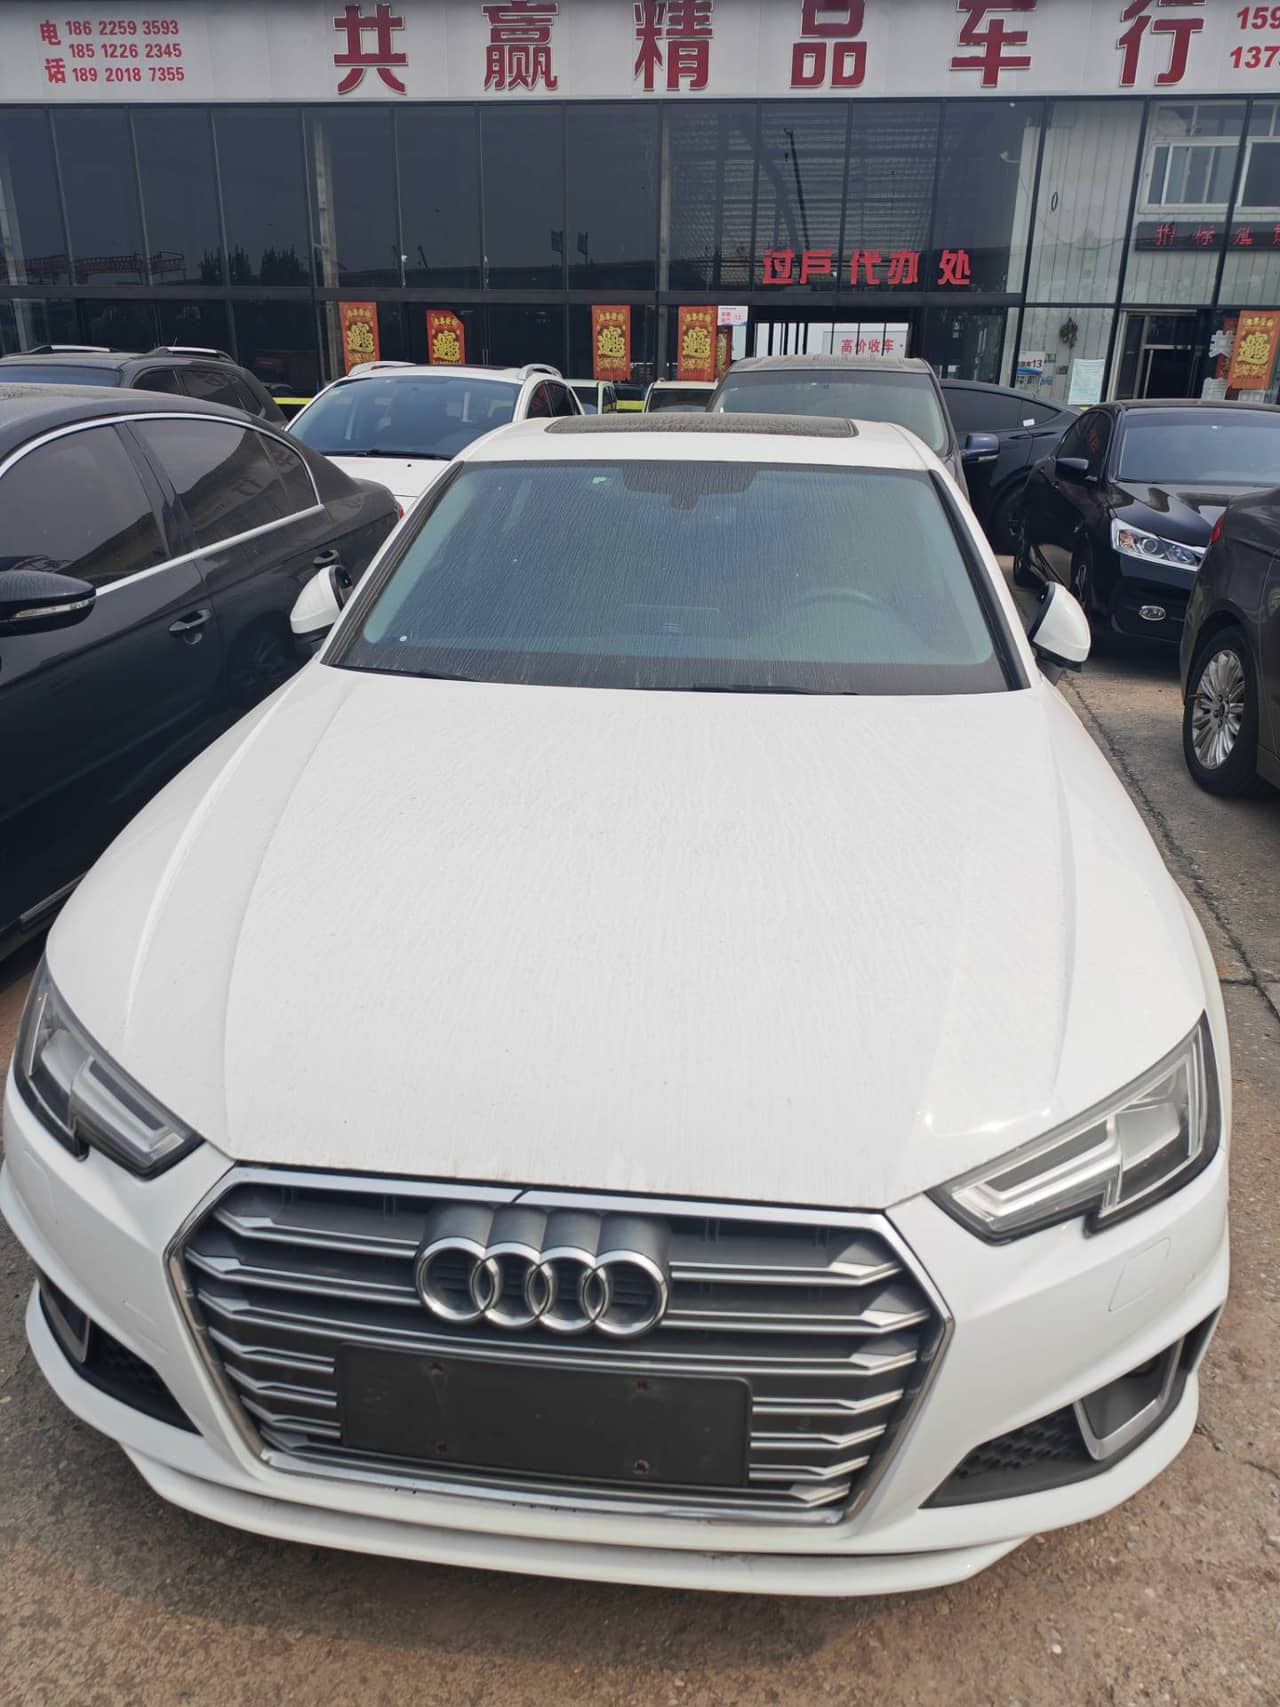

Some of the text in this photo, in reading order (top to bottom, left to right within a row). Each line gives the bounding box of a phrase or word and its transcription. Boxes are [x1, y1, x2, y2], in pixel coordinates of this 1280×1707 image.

[65, 20, 179, 36] 186 2259 3593
[39, 19, 66, 84] 电话
[69, 43, 182, 58] 185 1226 2345
[1230, 45, 1280, 69] 137
[72, 66, 185, 82] 189 2018 7355
[762, 248, 972, 286] 过户代办处
[840, 338, 895, 354] 高价收车
